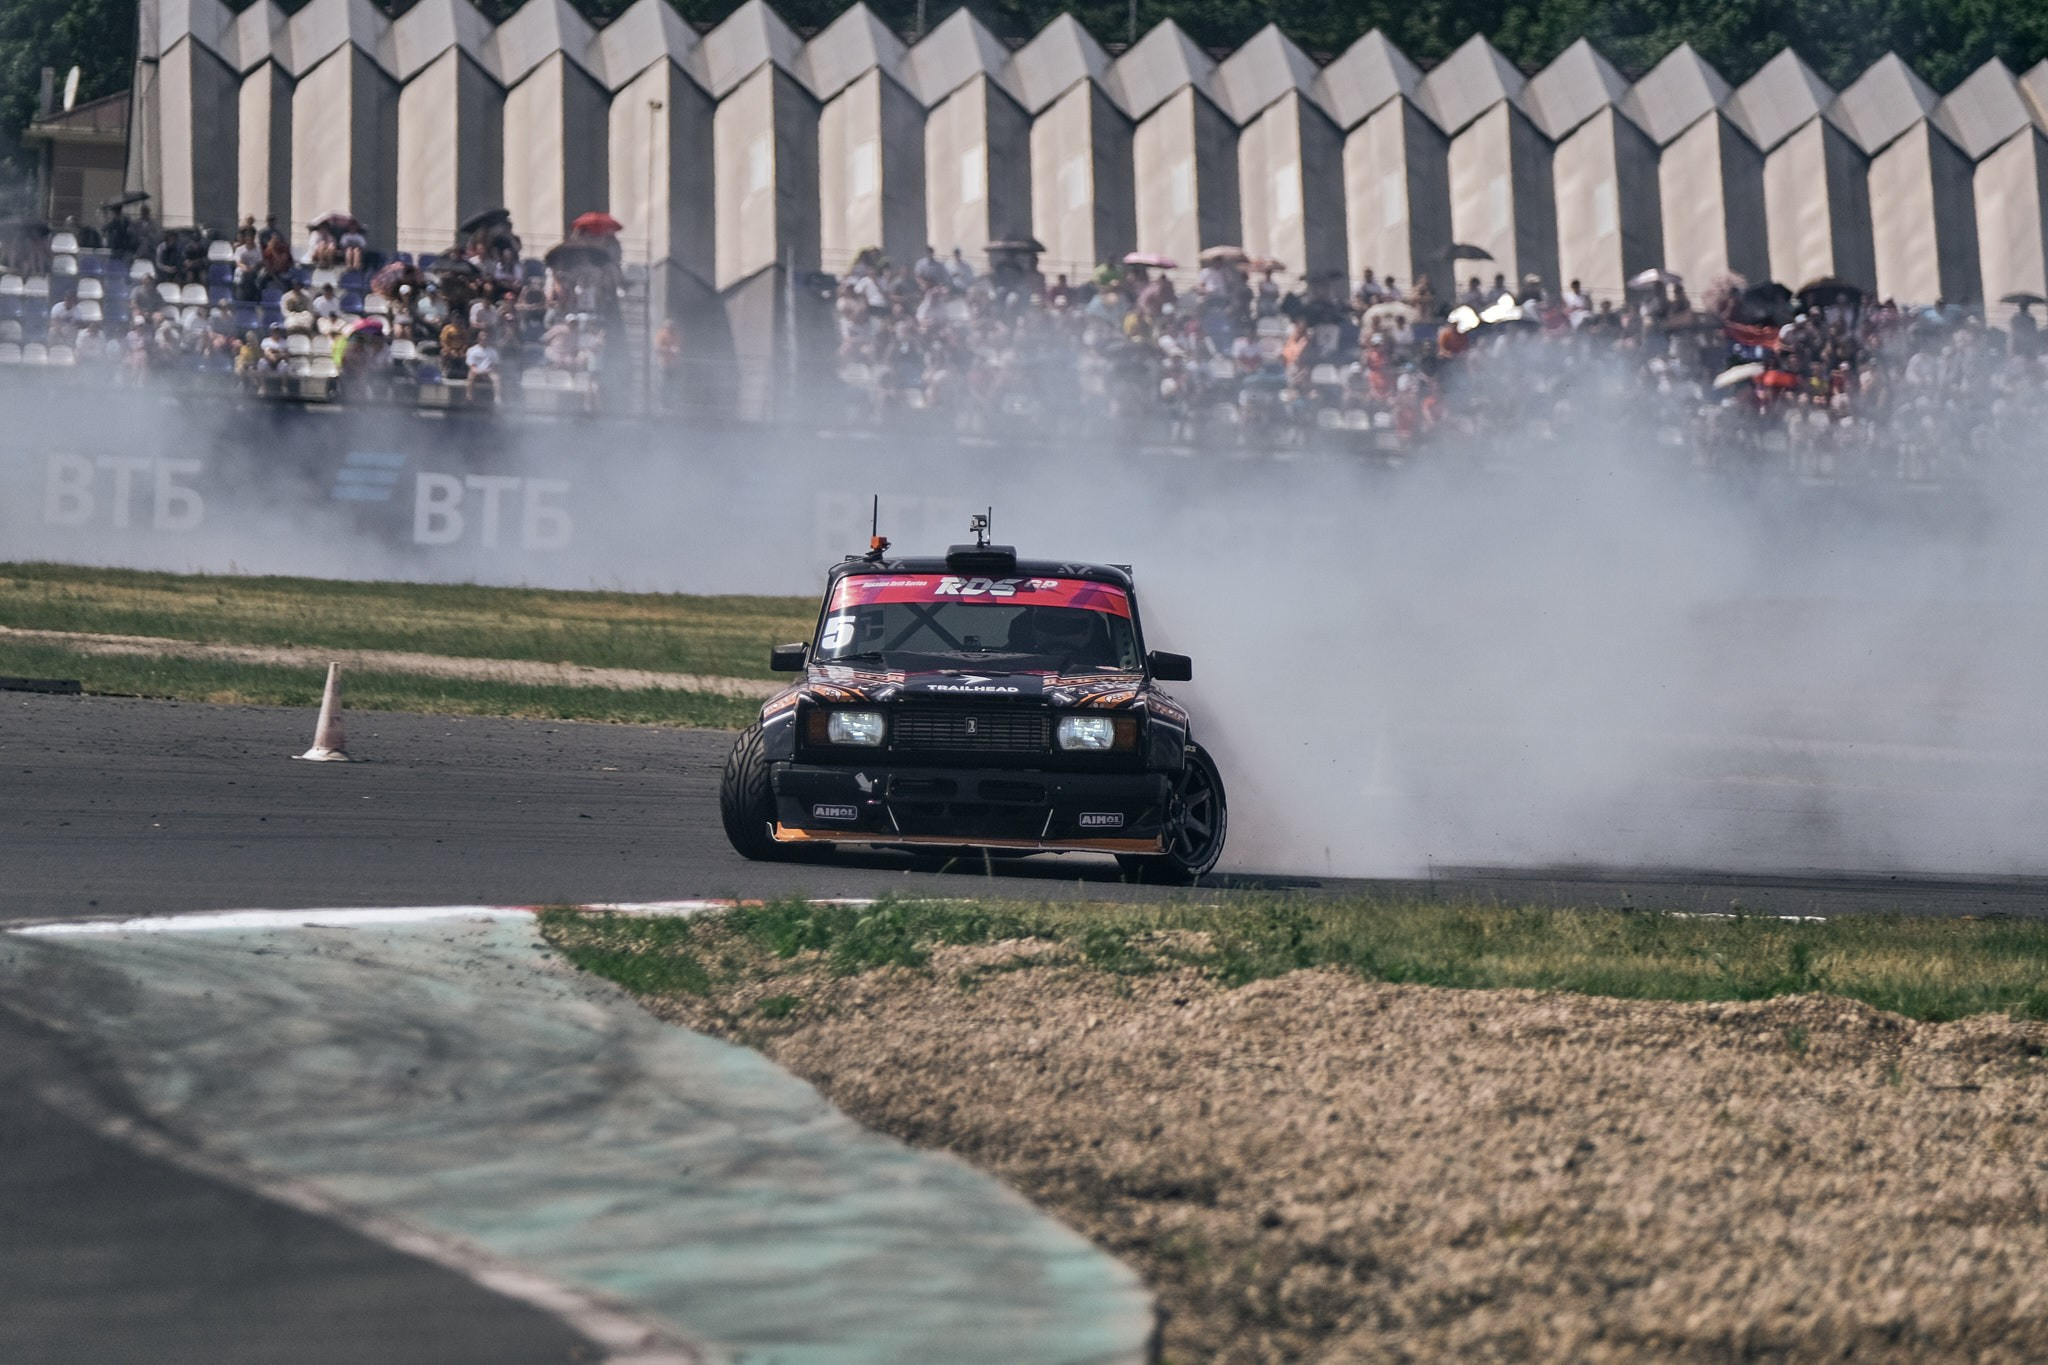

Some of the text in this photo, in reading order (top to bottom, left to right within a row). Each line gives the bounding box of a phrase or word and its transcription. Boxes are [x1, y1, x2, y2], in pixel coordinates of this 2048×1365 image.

[44, 452, 203, 530] ВТБ
[414, 473, 574, 549] ВТБ
[934, 576, 1059, 596] RDS GP
[821, 615, 856, 649] 5
[927, 684, 1019, 693] TRAILHEAD
[815, 806, 855, 819] AIMOL
[1082, 814, 1122, 827] AIMOL
